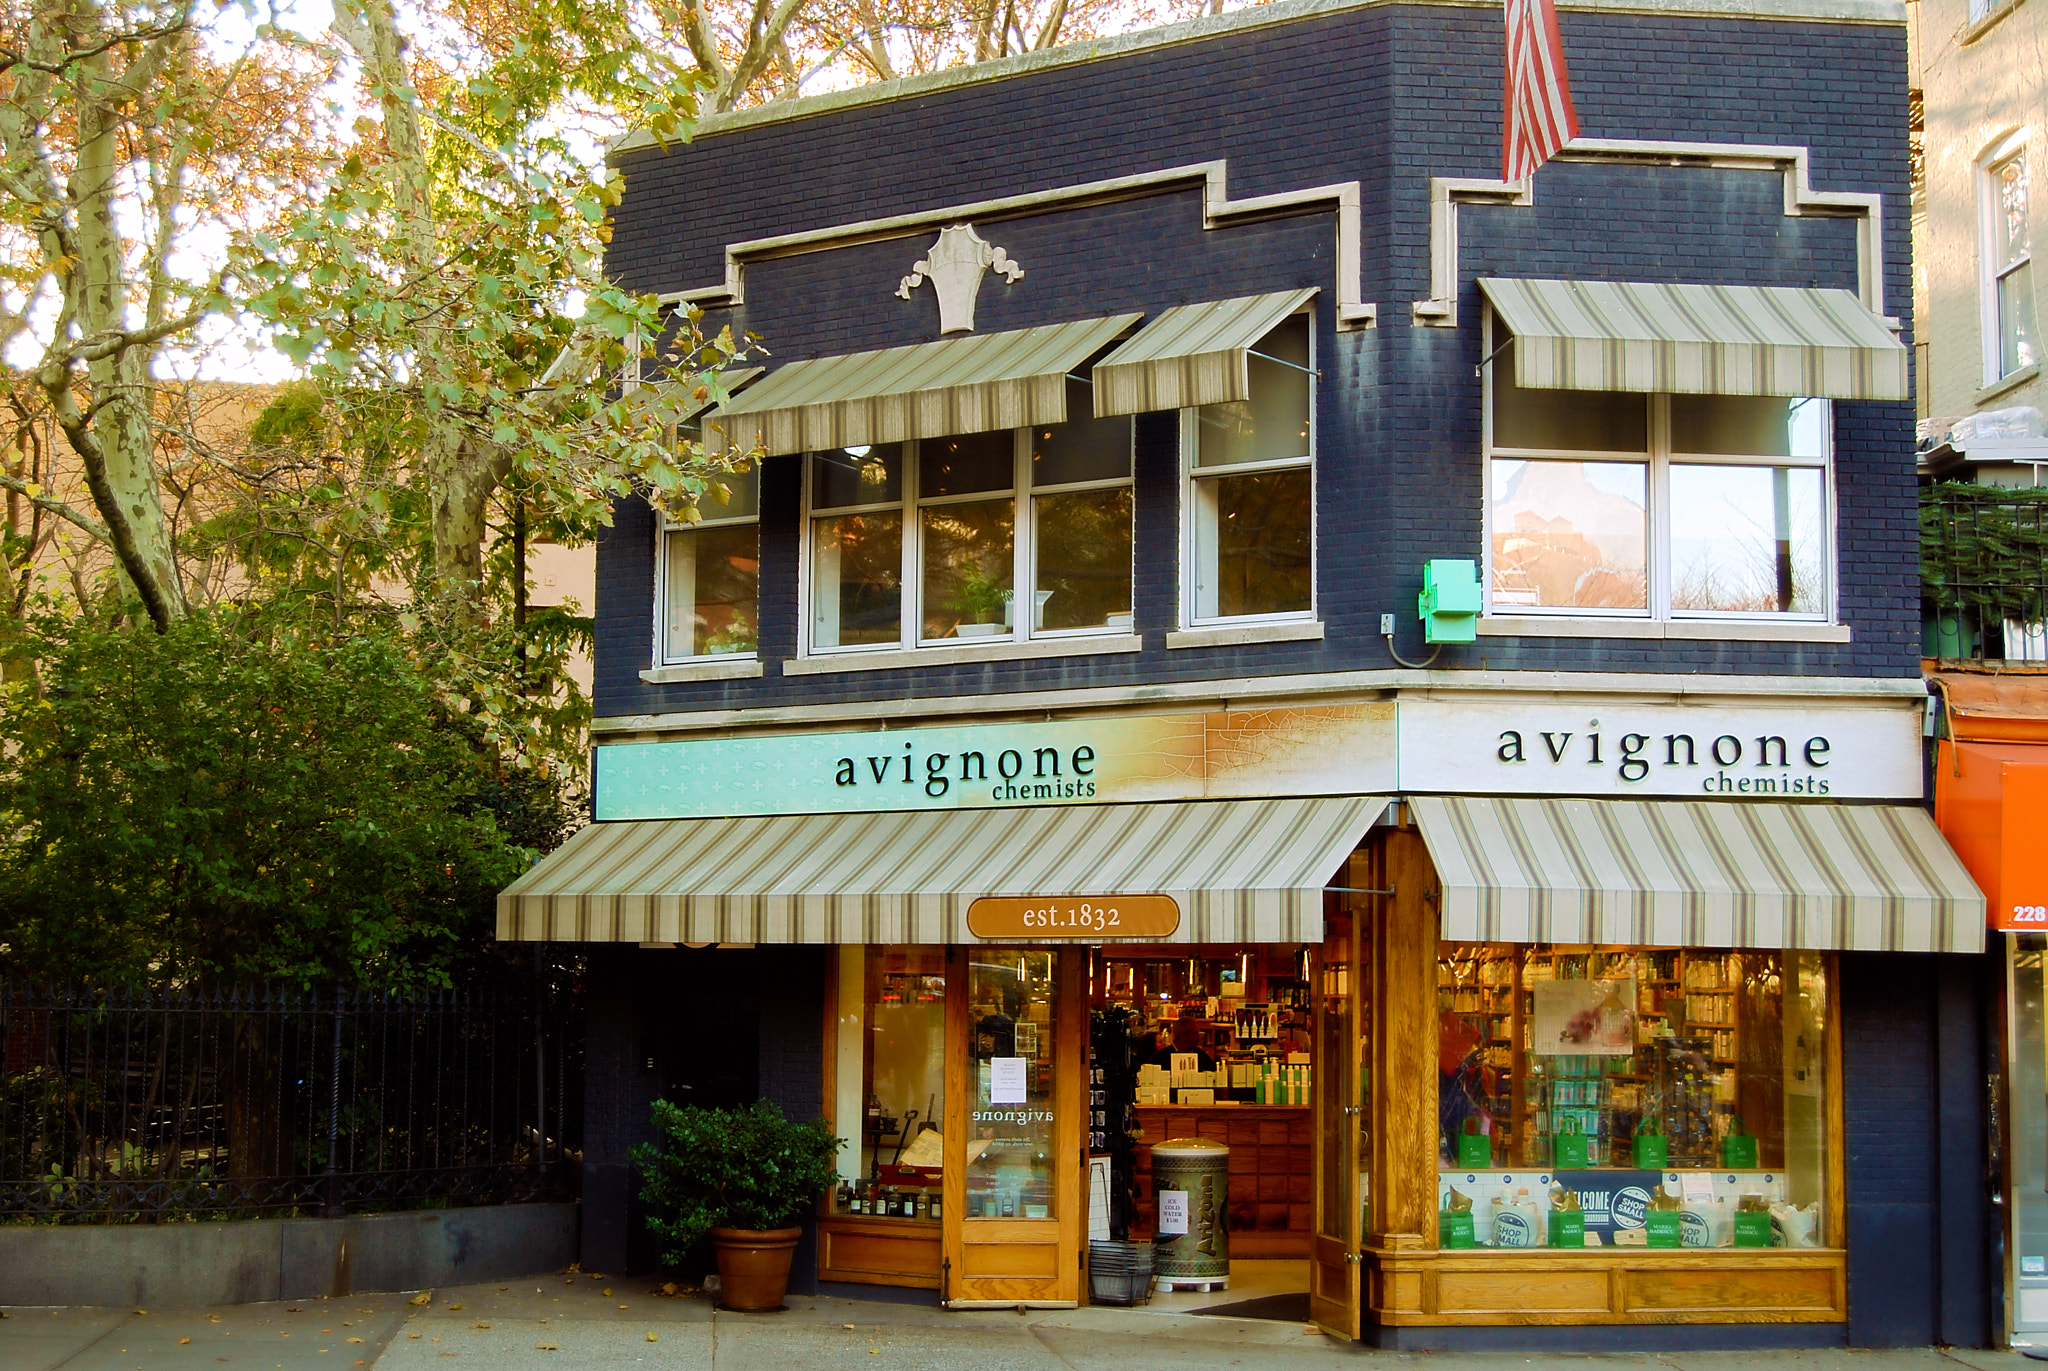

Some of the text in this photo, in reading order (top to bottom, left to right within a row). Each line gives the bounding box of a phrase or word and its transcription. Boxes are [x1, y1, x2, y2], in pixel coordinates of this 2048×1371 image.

[1497, 718, 1831, 782] avignone
[835, 741, 1095, 797] avignone
[992, 778, 1096, 801] chemists
[1702, 770, 1830, 795] chemists
[1022, 903, 1121, 931] est.1832
[2013, 905, 2046, 922] 228
[1617, 1204, 1644, 1219] SMALL
[1622, 1198, 1645, 1211] SHOP
[1497, 1225, 1521, 1238] SHOP
